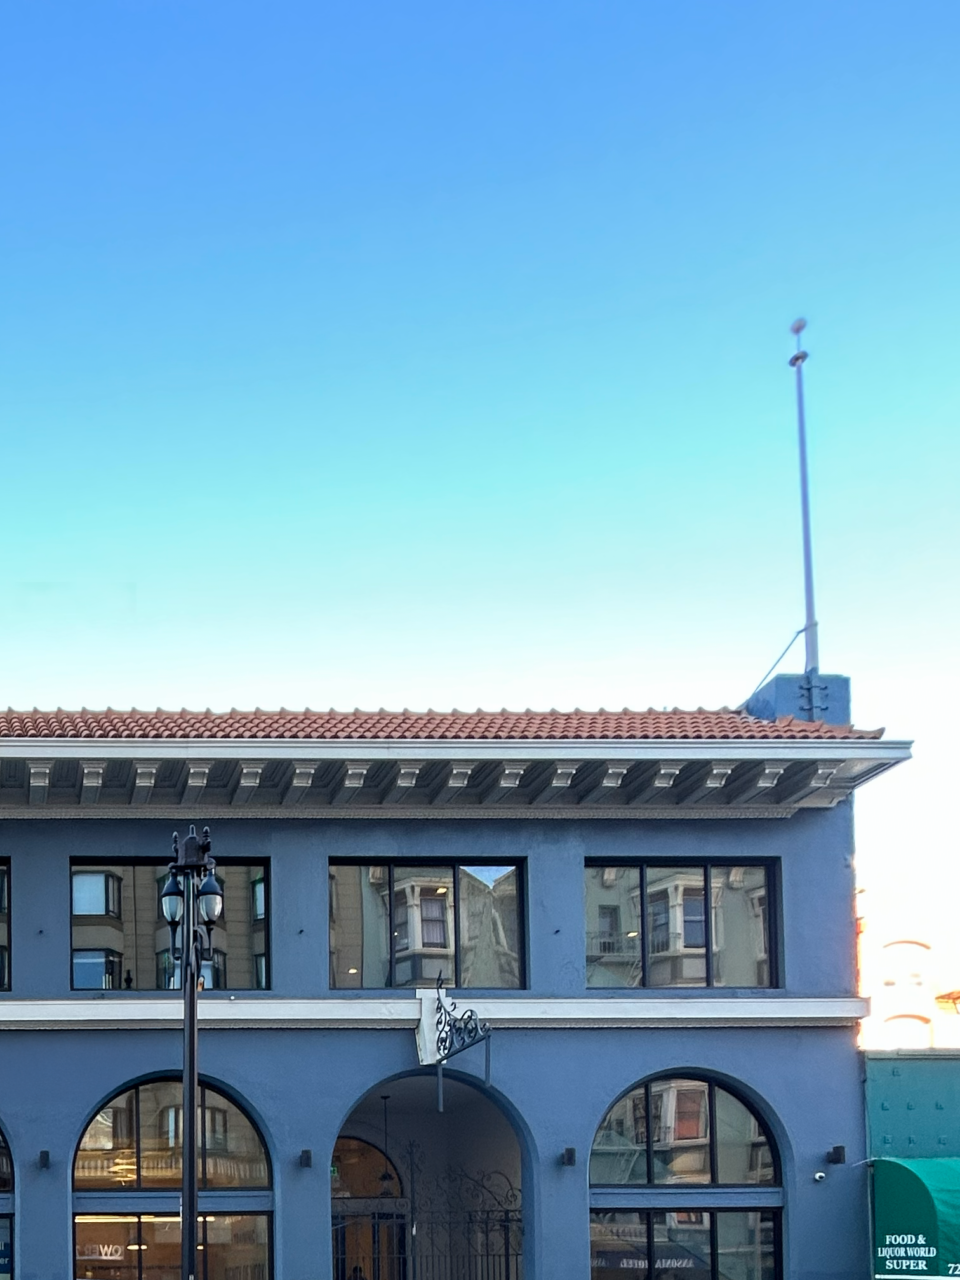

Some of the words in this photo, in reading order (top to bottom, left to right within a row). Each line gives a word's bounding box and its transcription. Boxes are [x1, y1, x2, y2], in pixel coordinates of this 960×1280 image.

[885, 1234, 915, 1245] FOOD
[917, 1234, 926, 1245] &
[877, 1247, 906, 1259] LIQUOR
[907, 1247, 937, 1257] WORLD
[885, 1259, 928, 1270] SUPER
